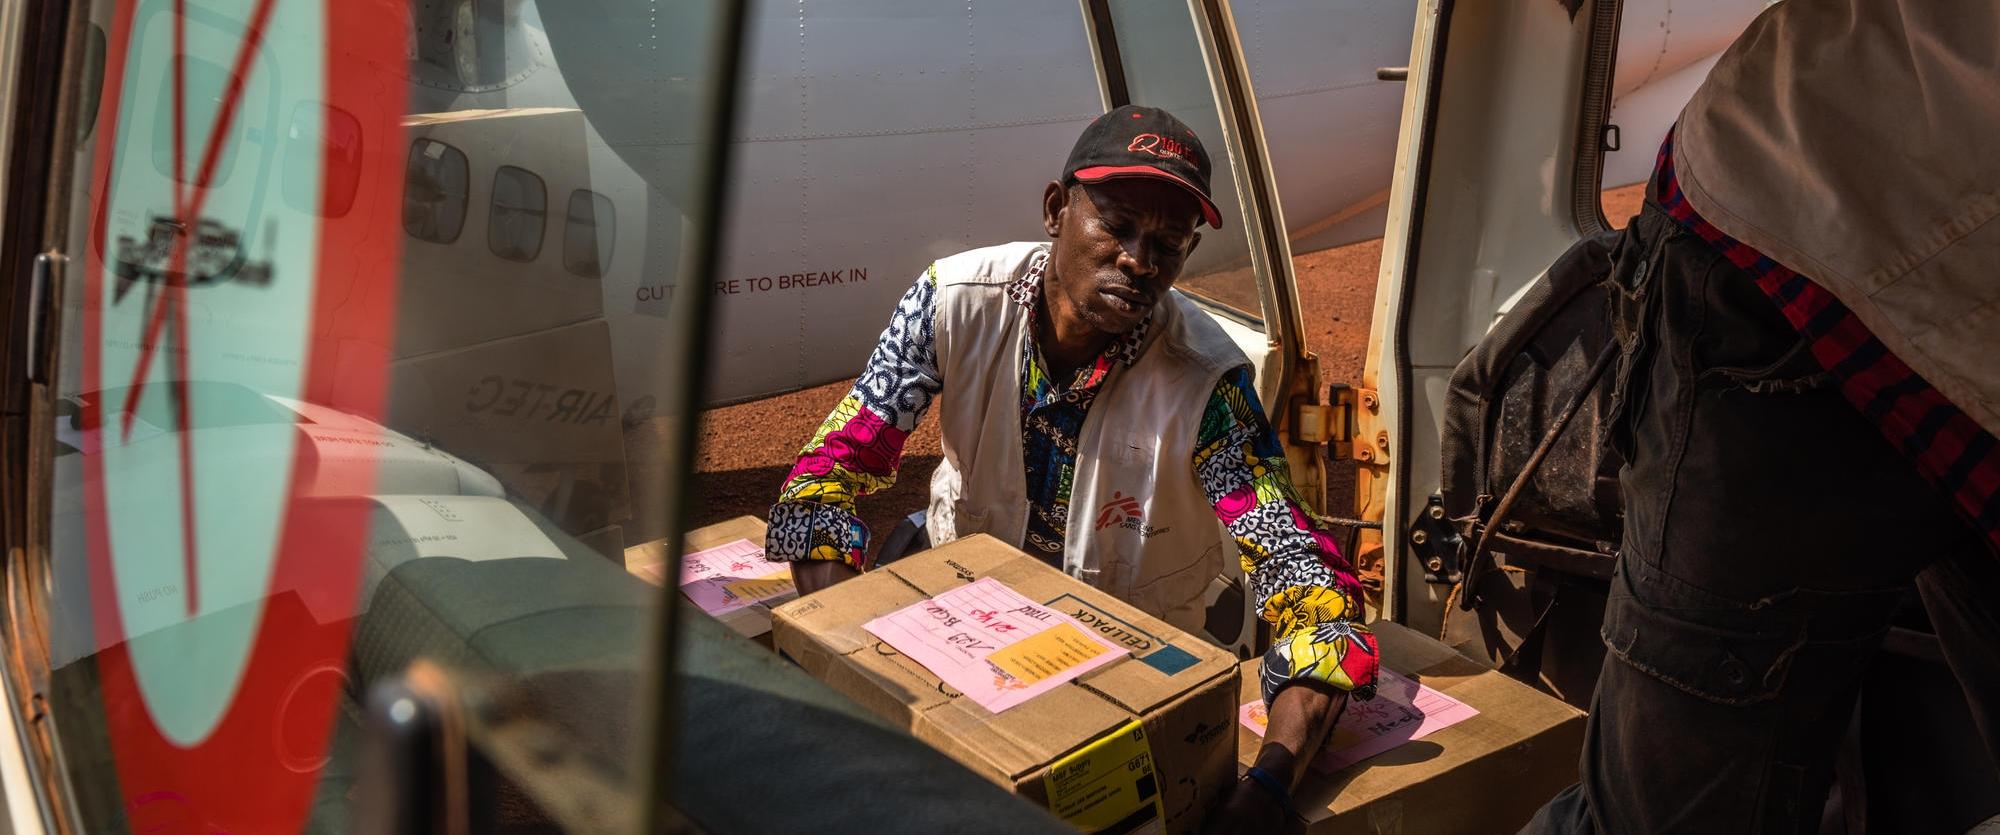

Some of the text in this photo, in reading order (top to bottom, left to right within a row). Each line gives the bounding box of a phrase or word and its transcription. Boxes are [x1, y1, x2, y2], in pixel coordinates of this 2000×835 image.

[636, 267, 868, 302] CUT RE TO BREAK IN
[1070, 608, 1151, 650] CELLPACK
[1128, 752, 1151, 772] G671
